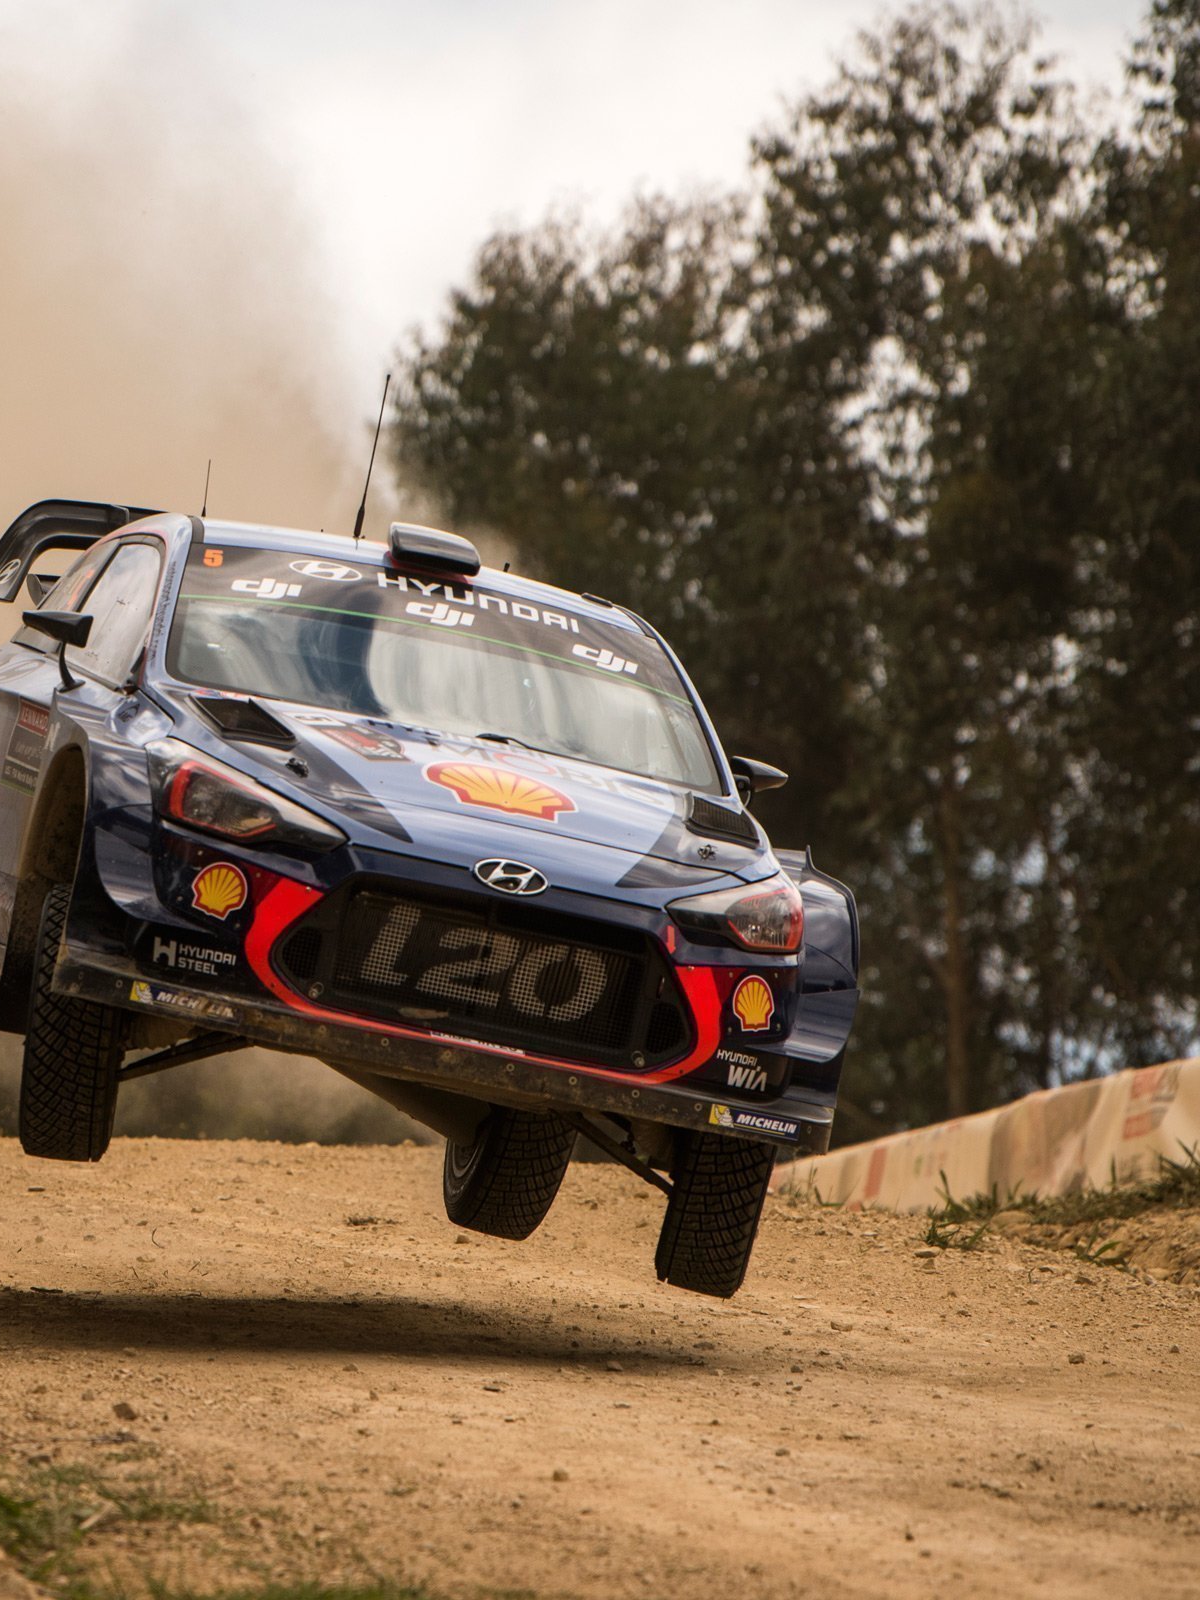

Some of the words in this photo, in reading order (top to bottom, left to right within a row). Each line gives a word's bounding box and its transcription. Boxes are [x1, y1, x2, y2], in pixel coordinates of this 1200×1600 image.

[203, 549, 224, 568] 5
[377, 572, 580, 634] HYUNDAI
[179, 943, 237, 966] HYUNDAI
[178, 957, 218, 976] STEEL
[156, 991, 234, 1018] MICHLIN
[717, 1048, 758, 1067] HYUNDAI
[736, 1113, 798, 1135] MICHELIN
